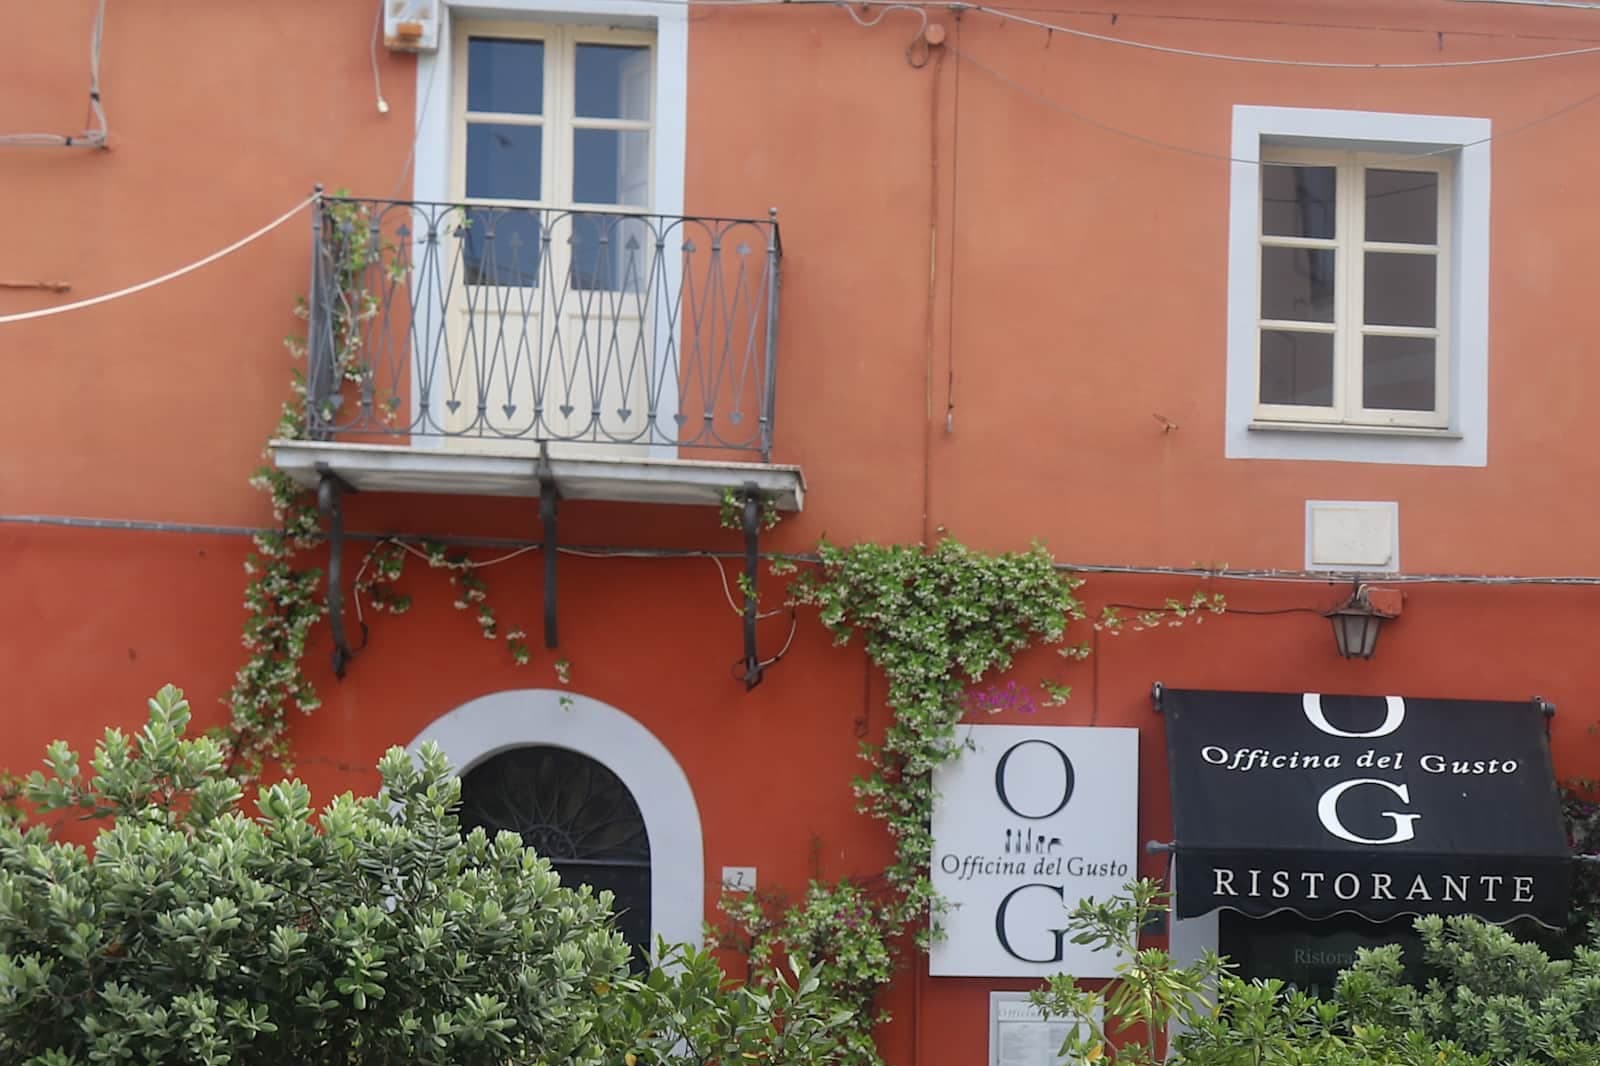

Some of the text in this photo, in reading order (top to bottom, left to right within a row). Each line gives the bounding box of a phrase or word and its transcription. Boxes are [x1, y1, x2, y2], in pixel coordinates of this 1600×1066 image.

[996, 739, 1076, 819] O
[1201, 746, 1519, 775] Officina del Gusto
[1317, 778, 1421, 844] G
[941, 855, 1128, 880] Officina del Gusto
[1213, 868, 1535, 902] RISTORANTE
[995, 883, 1065, 964] G
